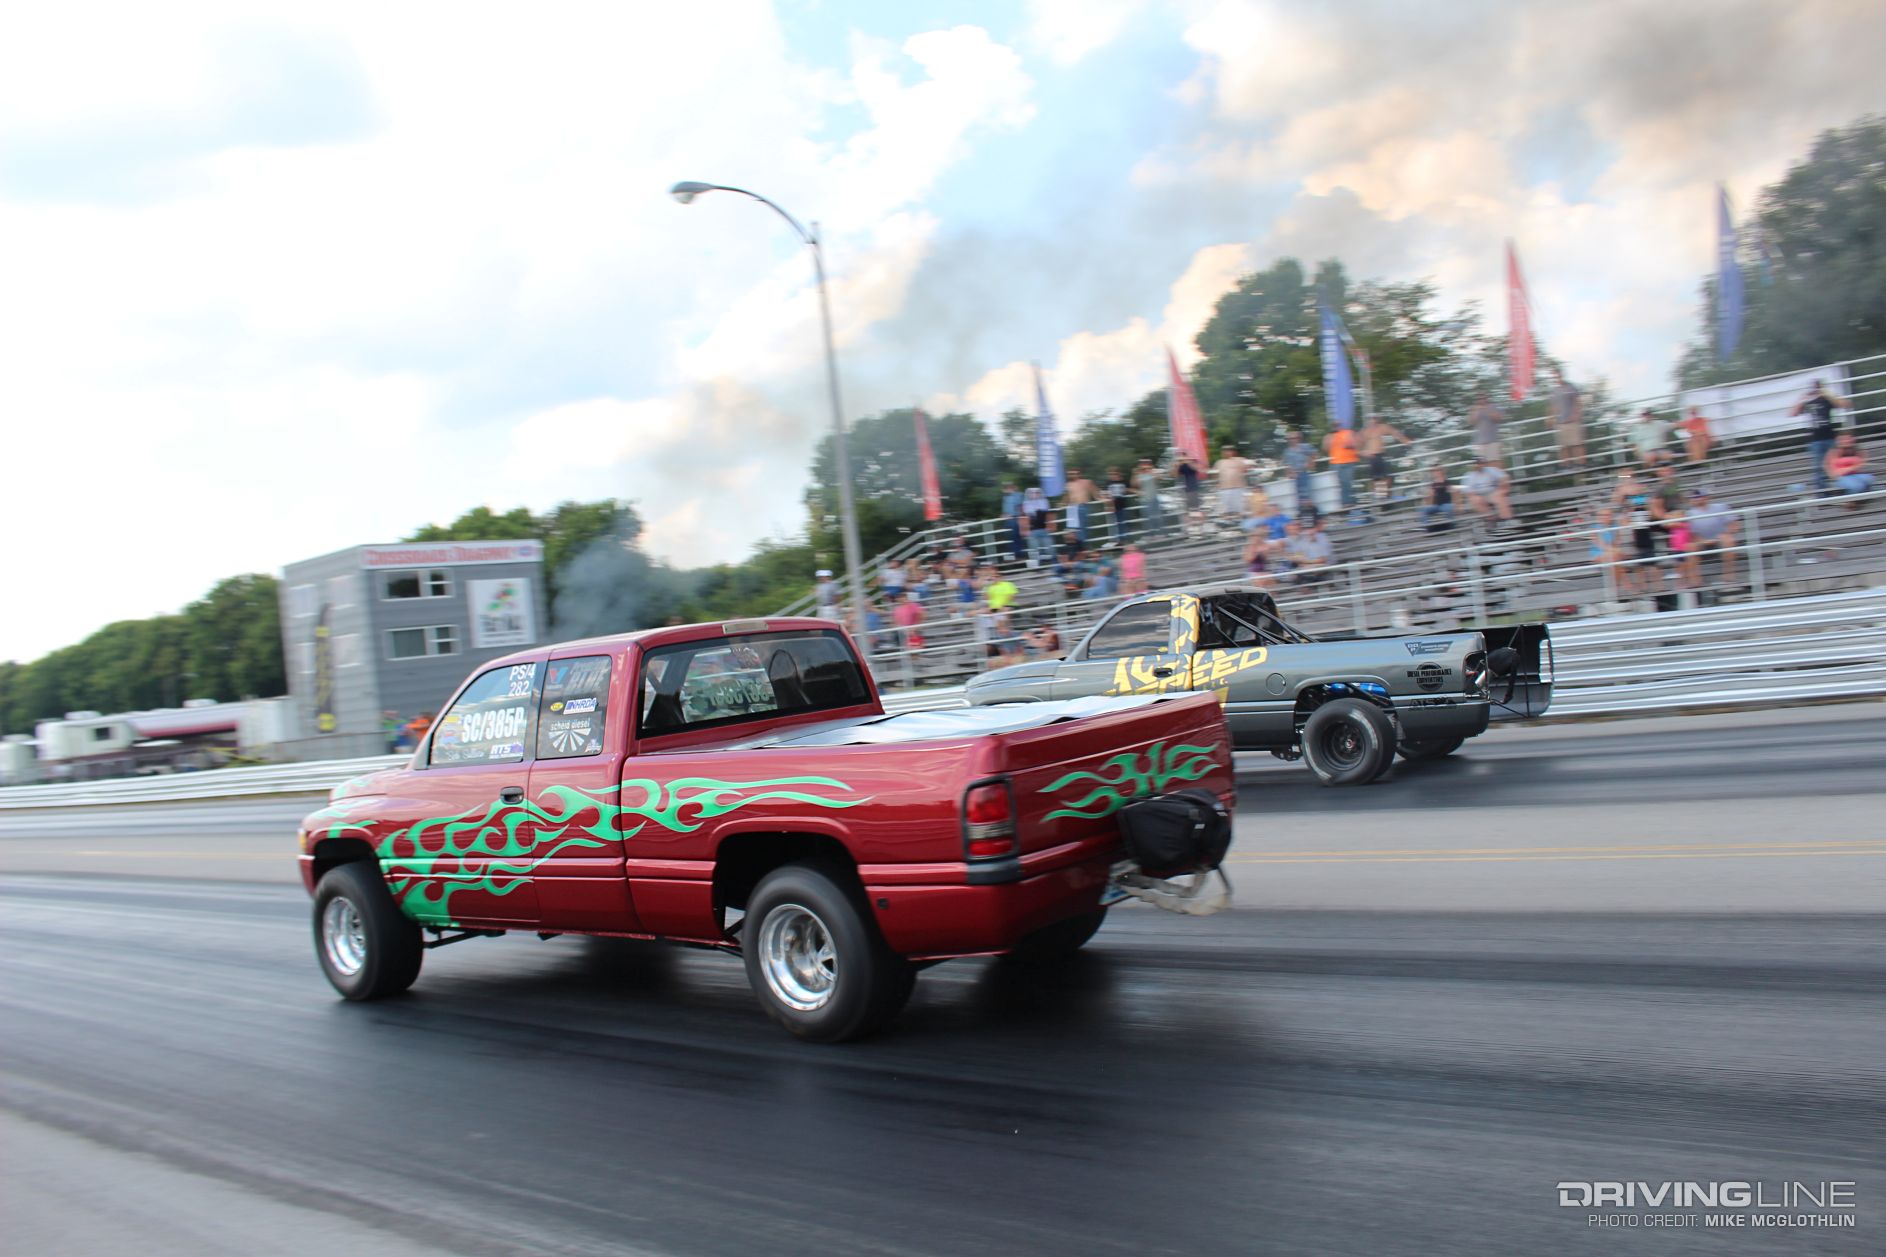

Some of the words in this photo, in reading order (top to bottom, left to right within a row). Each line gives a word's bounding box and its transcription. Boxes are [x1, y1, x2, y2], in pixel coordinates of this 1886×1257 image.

[510, 664, 536, 680] PS/4
[508, 681, 530, 697] 282
[462, 707, 525, 743] SC/385P
